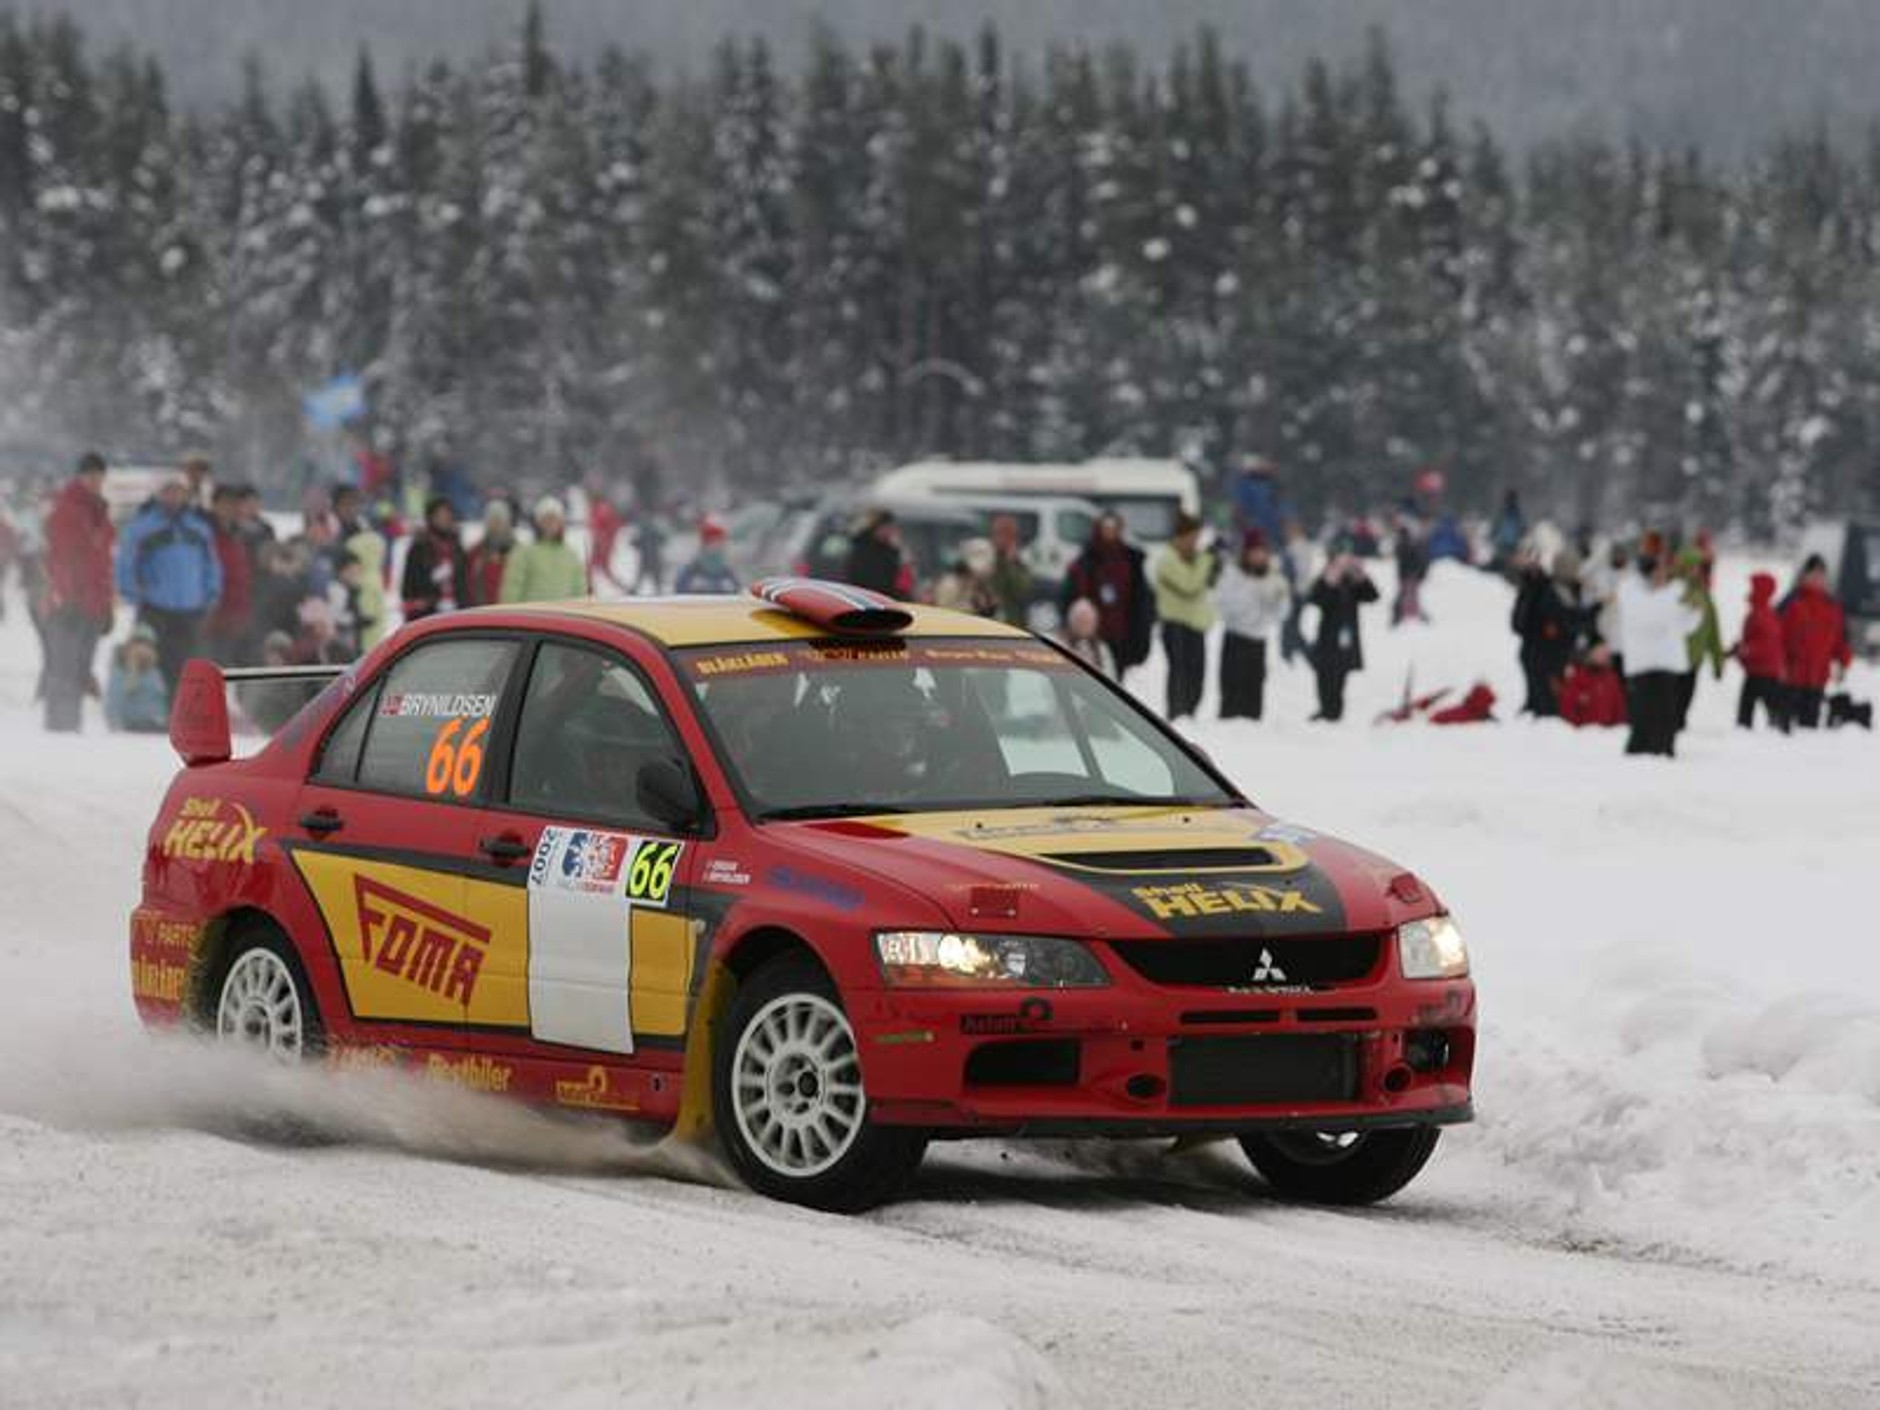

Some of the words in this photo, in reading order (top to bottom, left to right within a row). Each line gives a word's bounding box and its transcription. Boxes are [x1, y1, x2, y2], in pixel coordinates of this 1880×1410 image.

[400, 694, 498, 716] BRYNILDSEN
[426, 715, 491, 796] 66
[162, 812, 268, 865] HELIX
[530, 829, 557, 885] 2007
[629, 841, 679, 900] 66
[1142, 887, 1323, 919] HELIX
[353, 871, 492, 1006] FOMA
